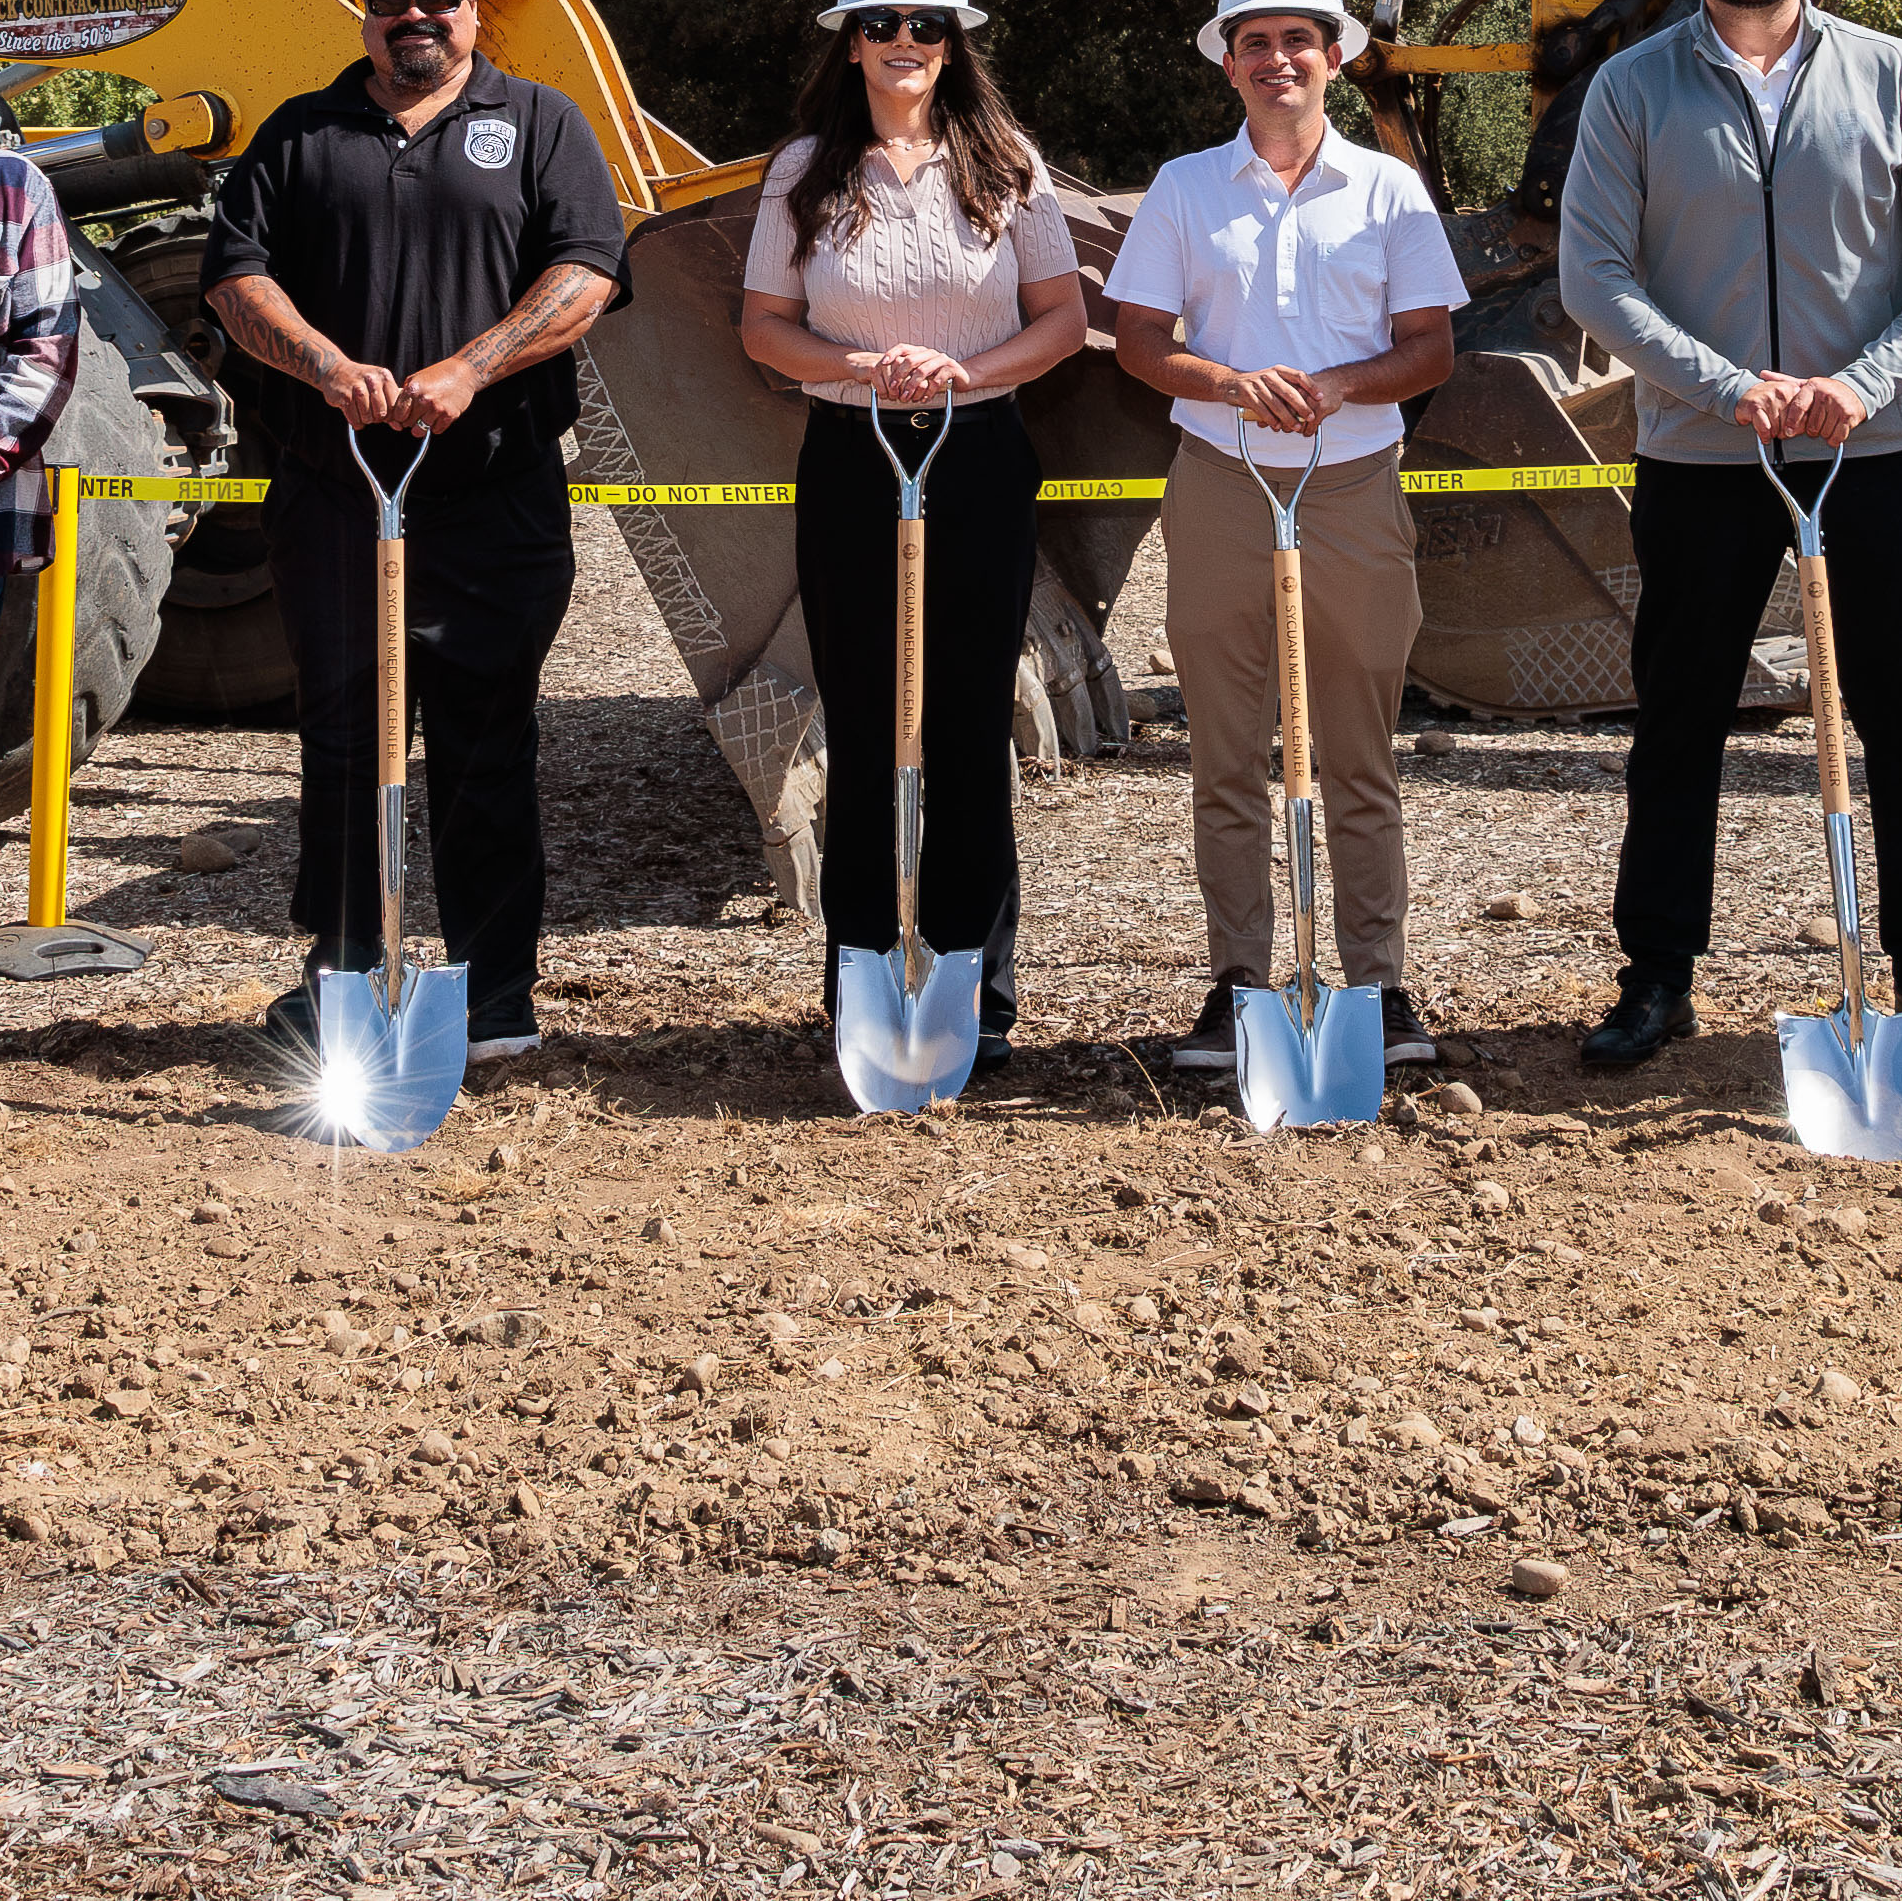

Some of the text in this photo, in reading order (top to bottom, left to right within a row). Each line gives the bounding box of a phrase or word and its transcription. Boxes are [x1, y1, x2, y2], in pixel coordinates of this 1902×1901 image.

[46, 32, 72, 51] the
[81, 478, 133, 497] NTER
[628, 486, 789, 502] DO NOT ENTER
[387, 589, 398, 759] SYCUAN MEDICAL CENTER
[903, 571, 915, 740] SYCUAN MEDICAL CENTER
[1285, 605, 1305, 778] SYCUAN MEDICAL CENTER
[1813, 610, 1841, 787] SYCUAN MEDICAL CENTER
